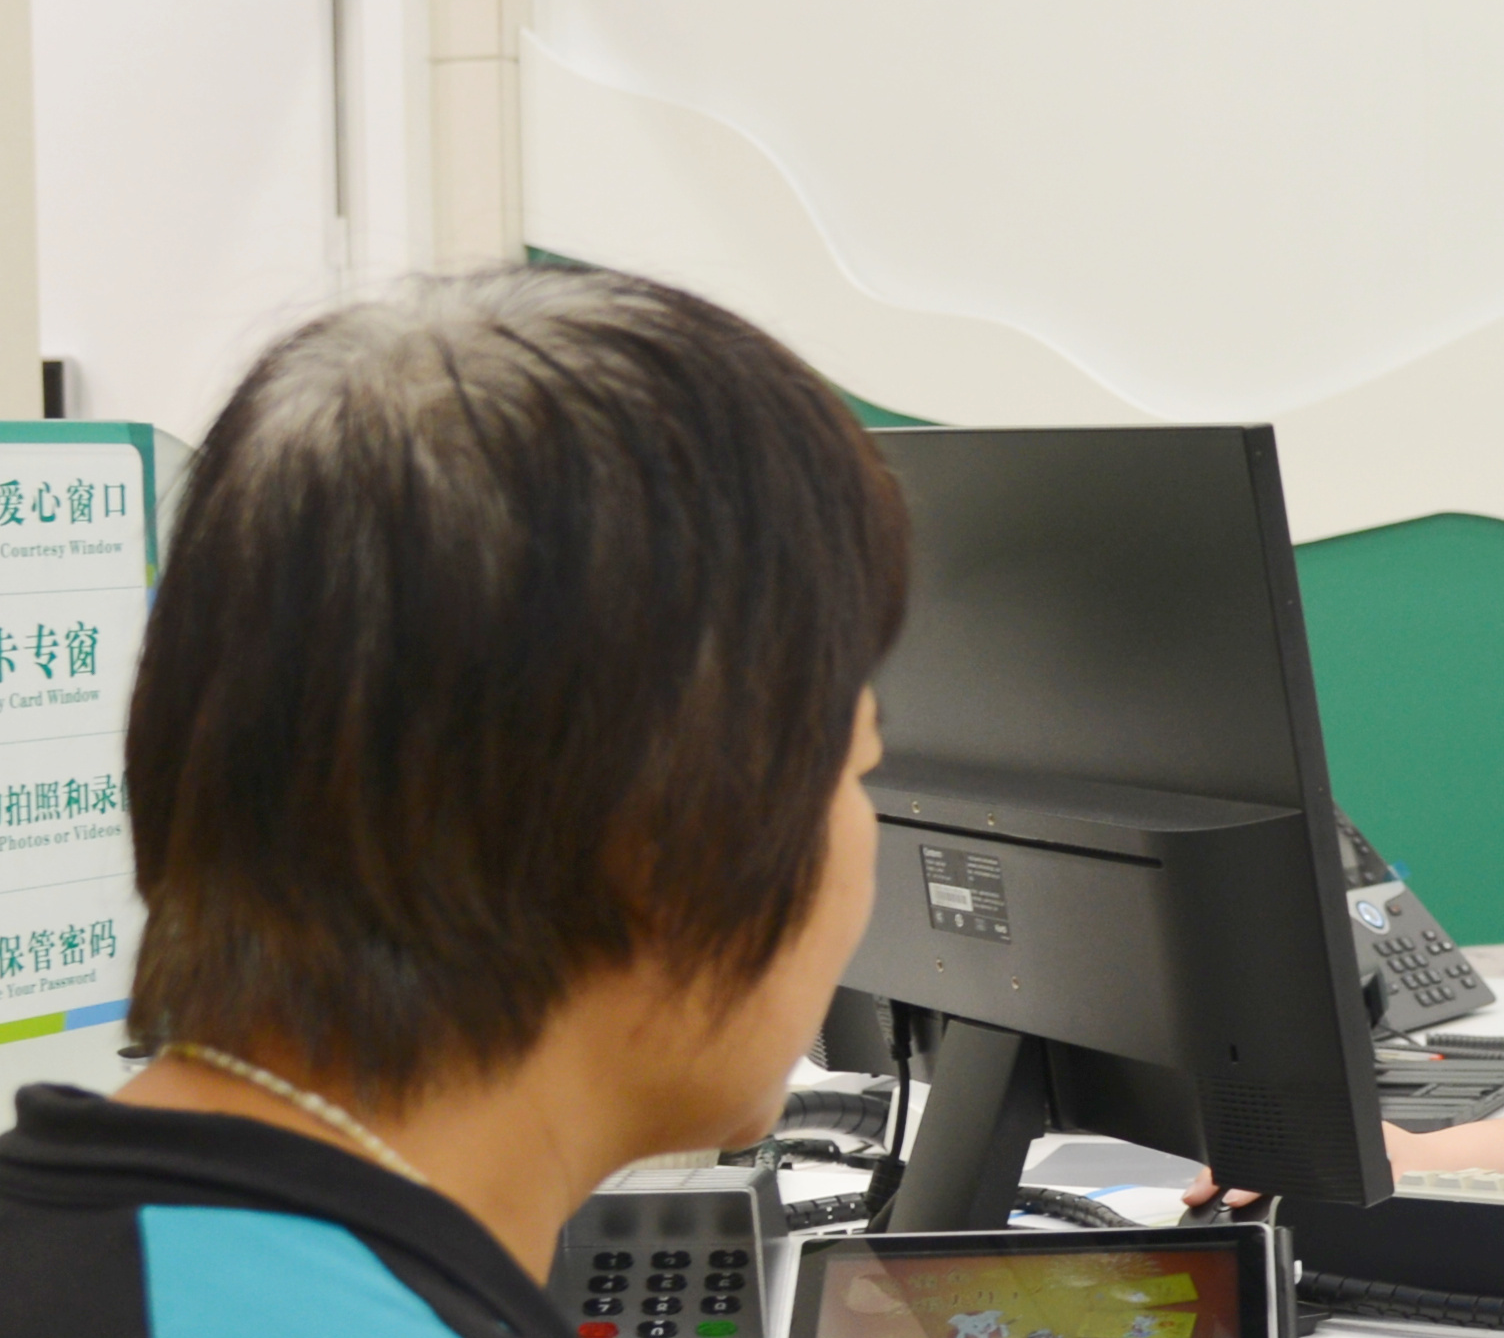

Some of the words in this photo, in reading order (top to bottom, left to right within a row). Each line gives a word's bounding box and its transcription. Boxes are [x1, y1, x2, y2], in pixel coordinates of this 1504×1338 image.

[0, 541, 65, 558] Courtesy
[69, 540, 123, 556] Window
[9, 691, 43, 710] Card
[47, 688, 100, 706] Window
[54, 830, 69, 844] or
[73, 823, 122, 842] Videos
[5, 982, 36, 1000] Your
[39, 970, 96, 993] Password
